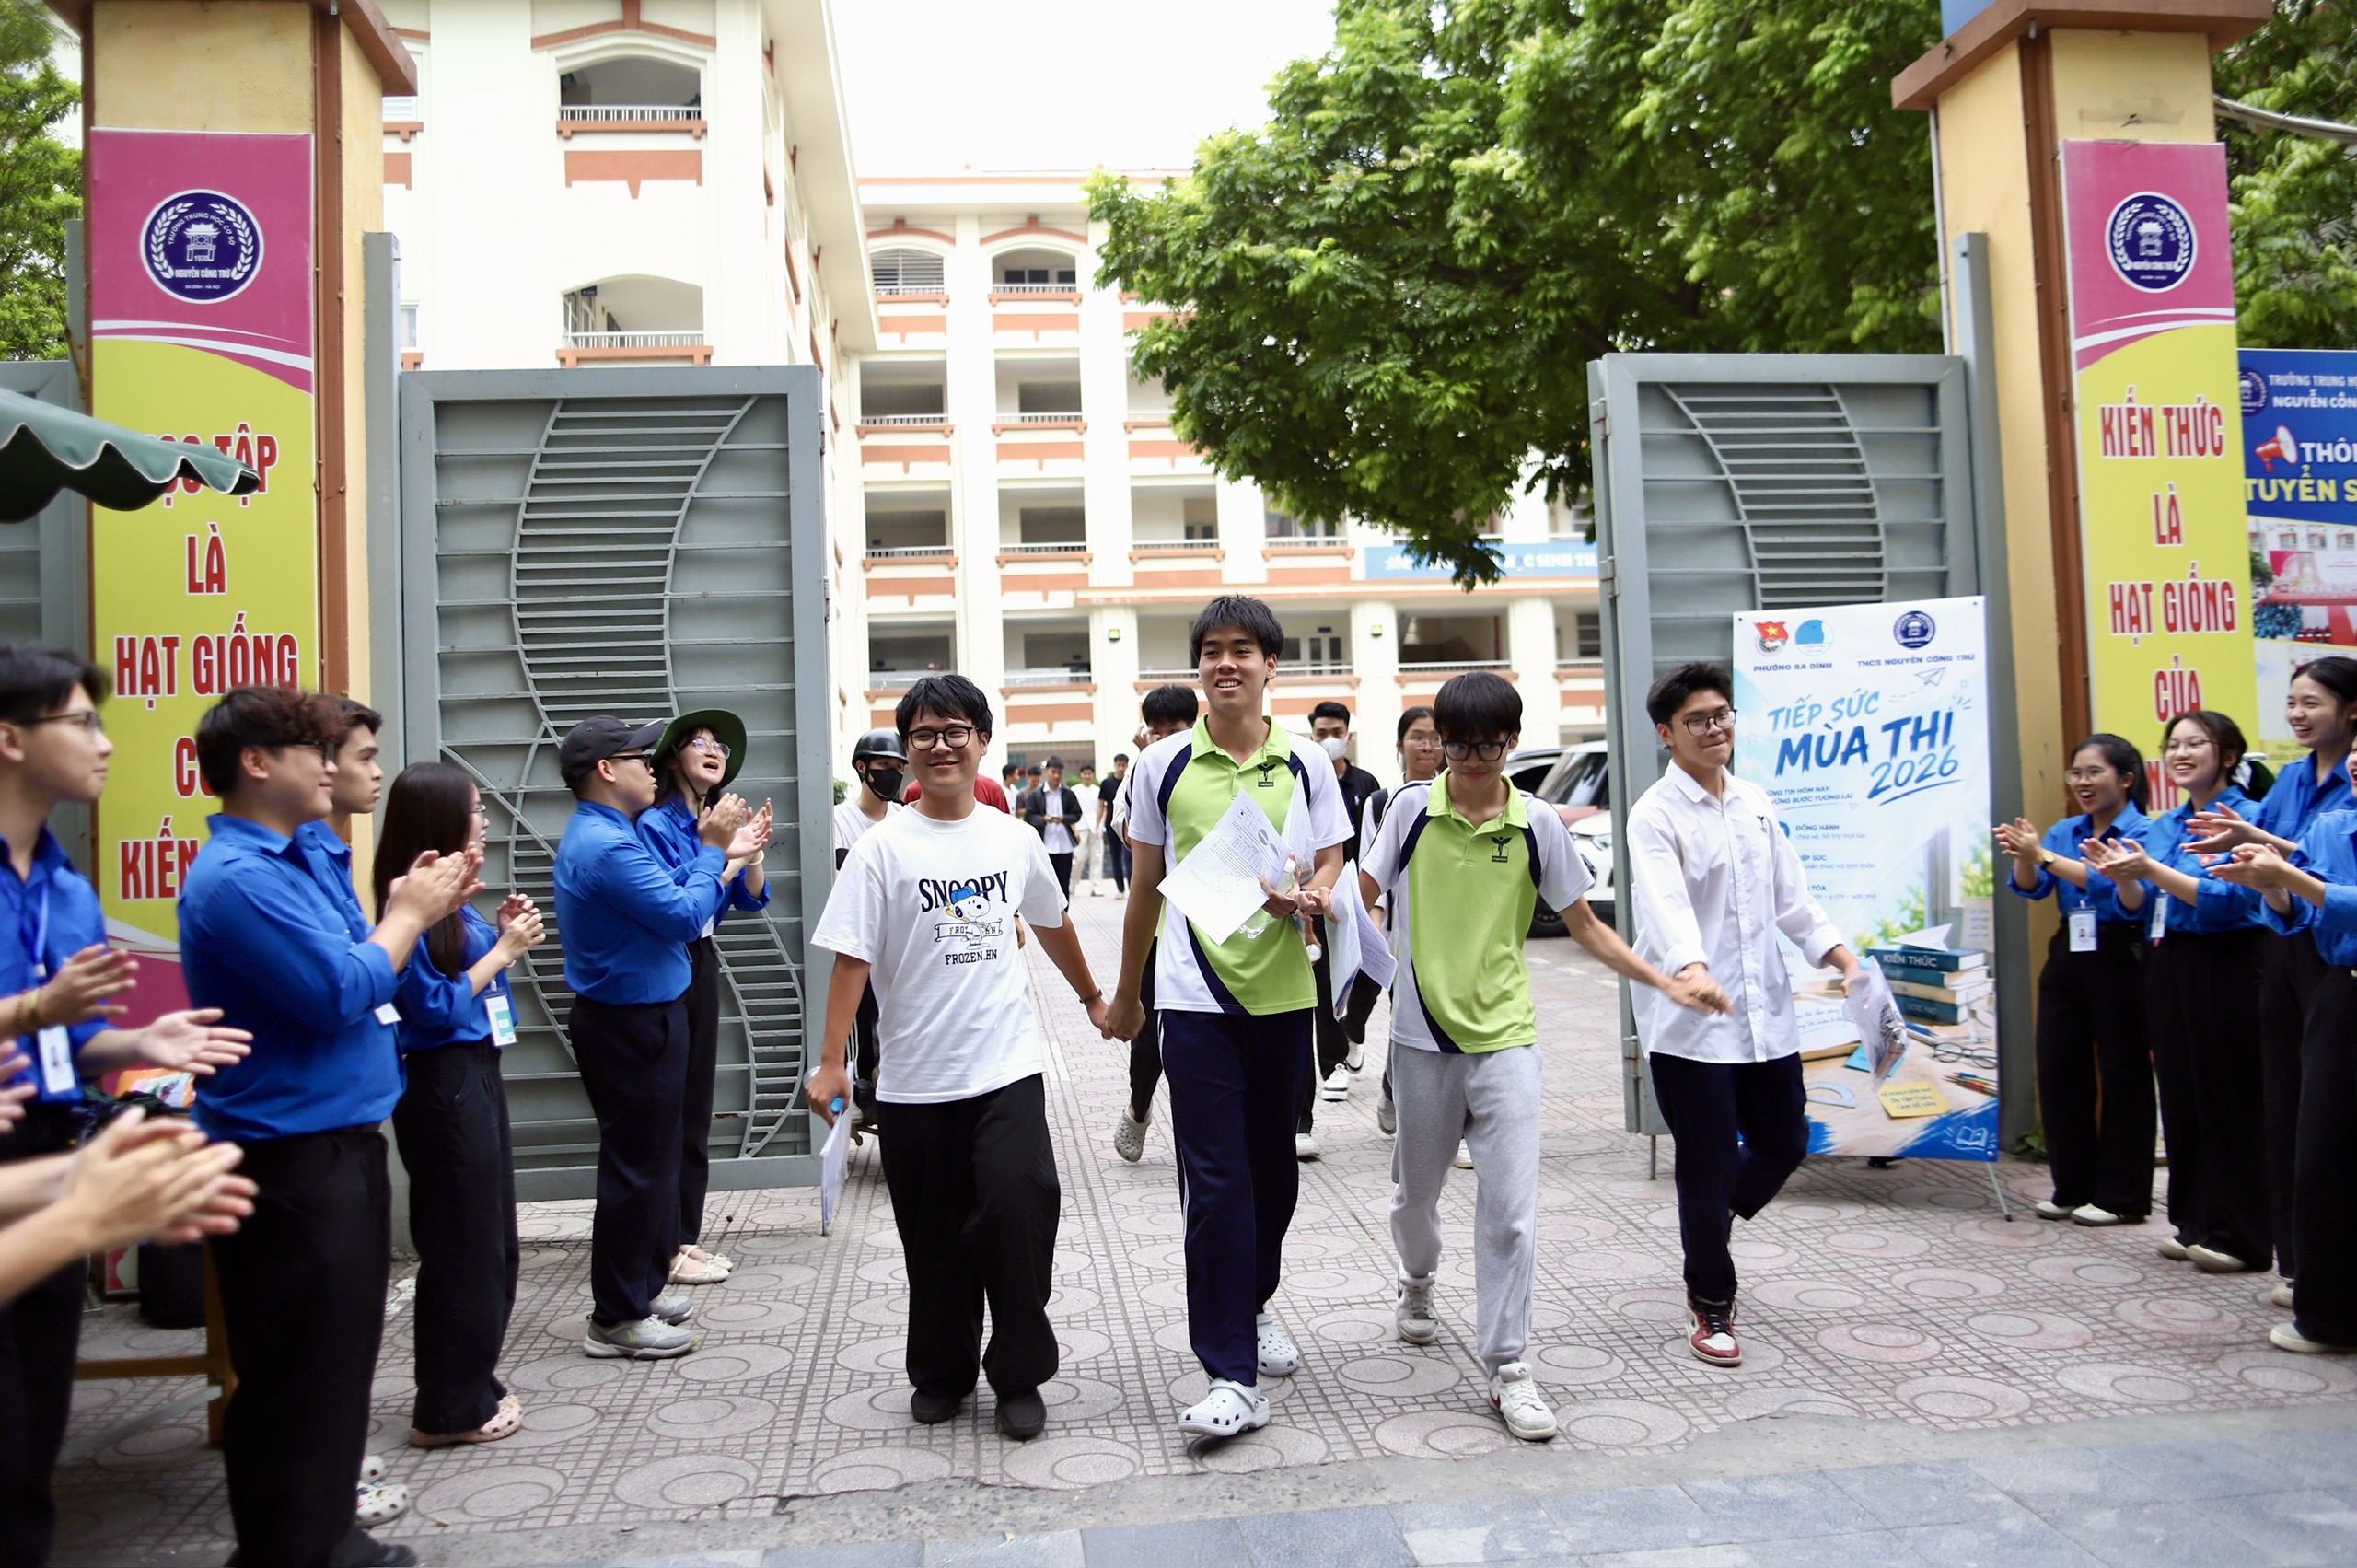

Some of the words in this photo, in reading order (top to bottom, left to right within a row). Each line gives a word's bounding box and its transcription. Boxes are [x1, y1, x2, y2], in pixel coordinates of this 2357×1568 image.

[184, 212, 209, 222] TRUNG
[200, 267, 218, 278] CÔNG
[2100, 385, 2154, 456] KIẾN
[2162, 396, 2224, 456] THỨC
[2272, 389, 2328, 408] NGUYỄN
[2245, 464, 2338, 502] TUYỂN
[2153, 482, 2183, 545] LÀ
[187, 522, 226, 594] LÀ
[2109, 581, 2154, 645] HẠT
[2164, 562, 2236, 633] GIỐNG
[115, 635, 180, 709] HẠT
[192, 612, 298, 695] GIỐNG
[1794, 662, 1807, 671] BA
[1809, 661, 1832, 670] ĐÌNH
[1857, 659, 1881, 668] THCS
[1926, 654, 1953, 664] CÔNG
[1767, 693, 1823, 734] TIẾP
[1830, 687, 1880, 722] SỨC
[2154, 655, 2201, 722] CỦA
[1774, 722, 1869, 778] MÙA
[1881, 706, 1954, 761] THI
[1866, 744, 1959, 800] 2026
[121, 816, 198, 899] KIẾN
[919, 870, 1007, 912] SNOOPY
[1883, 951, 1906, 964] KIẾN
[1908, 952, 1937, 968] THỨC
